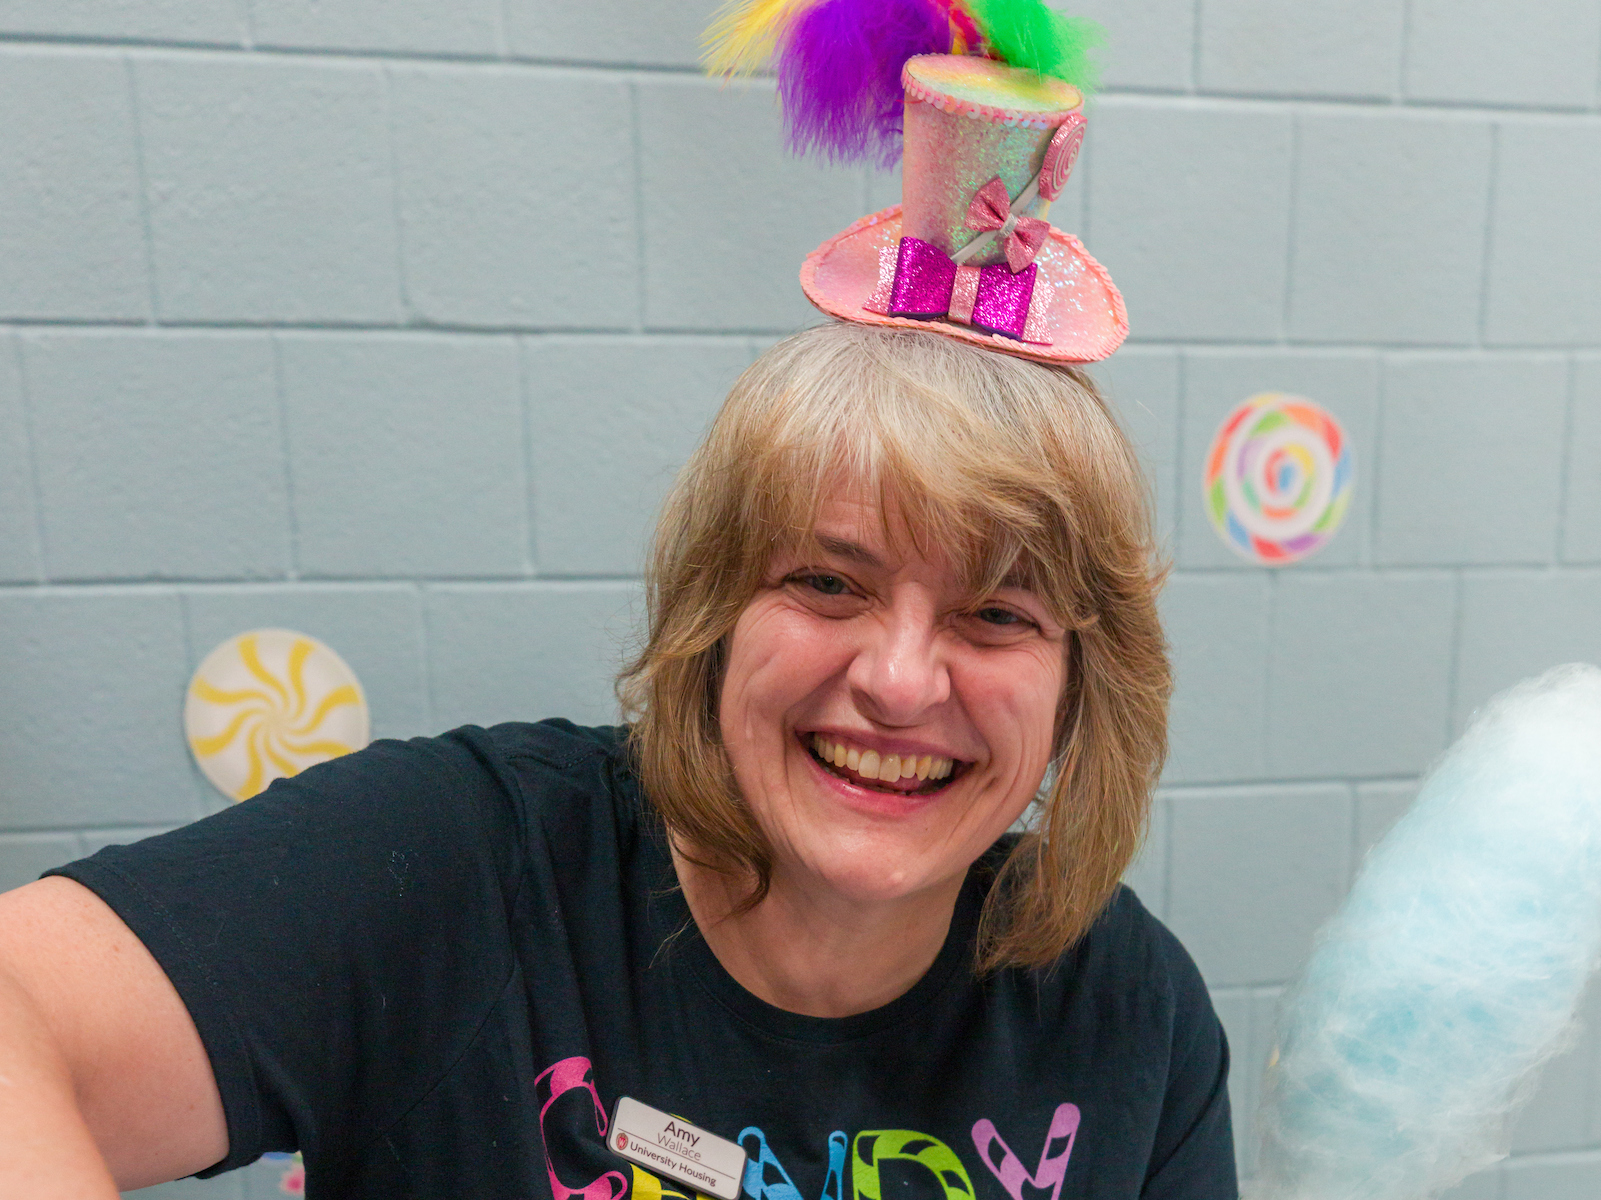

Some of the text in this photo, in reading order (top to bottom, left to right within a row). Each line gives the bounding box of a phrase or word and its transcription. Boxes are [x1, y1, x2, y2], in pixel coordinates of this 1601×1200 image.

[657, 1132, 702, 1161] Wallace
[664, 1121, 701, 1147] Amy
[630, 1141, 717, 1187] University Housing
